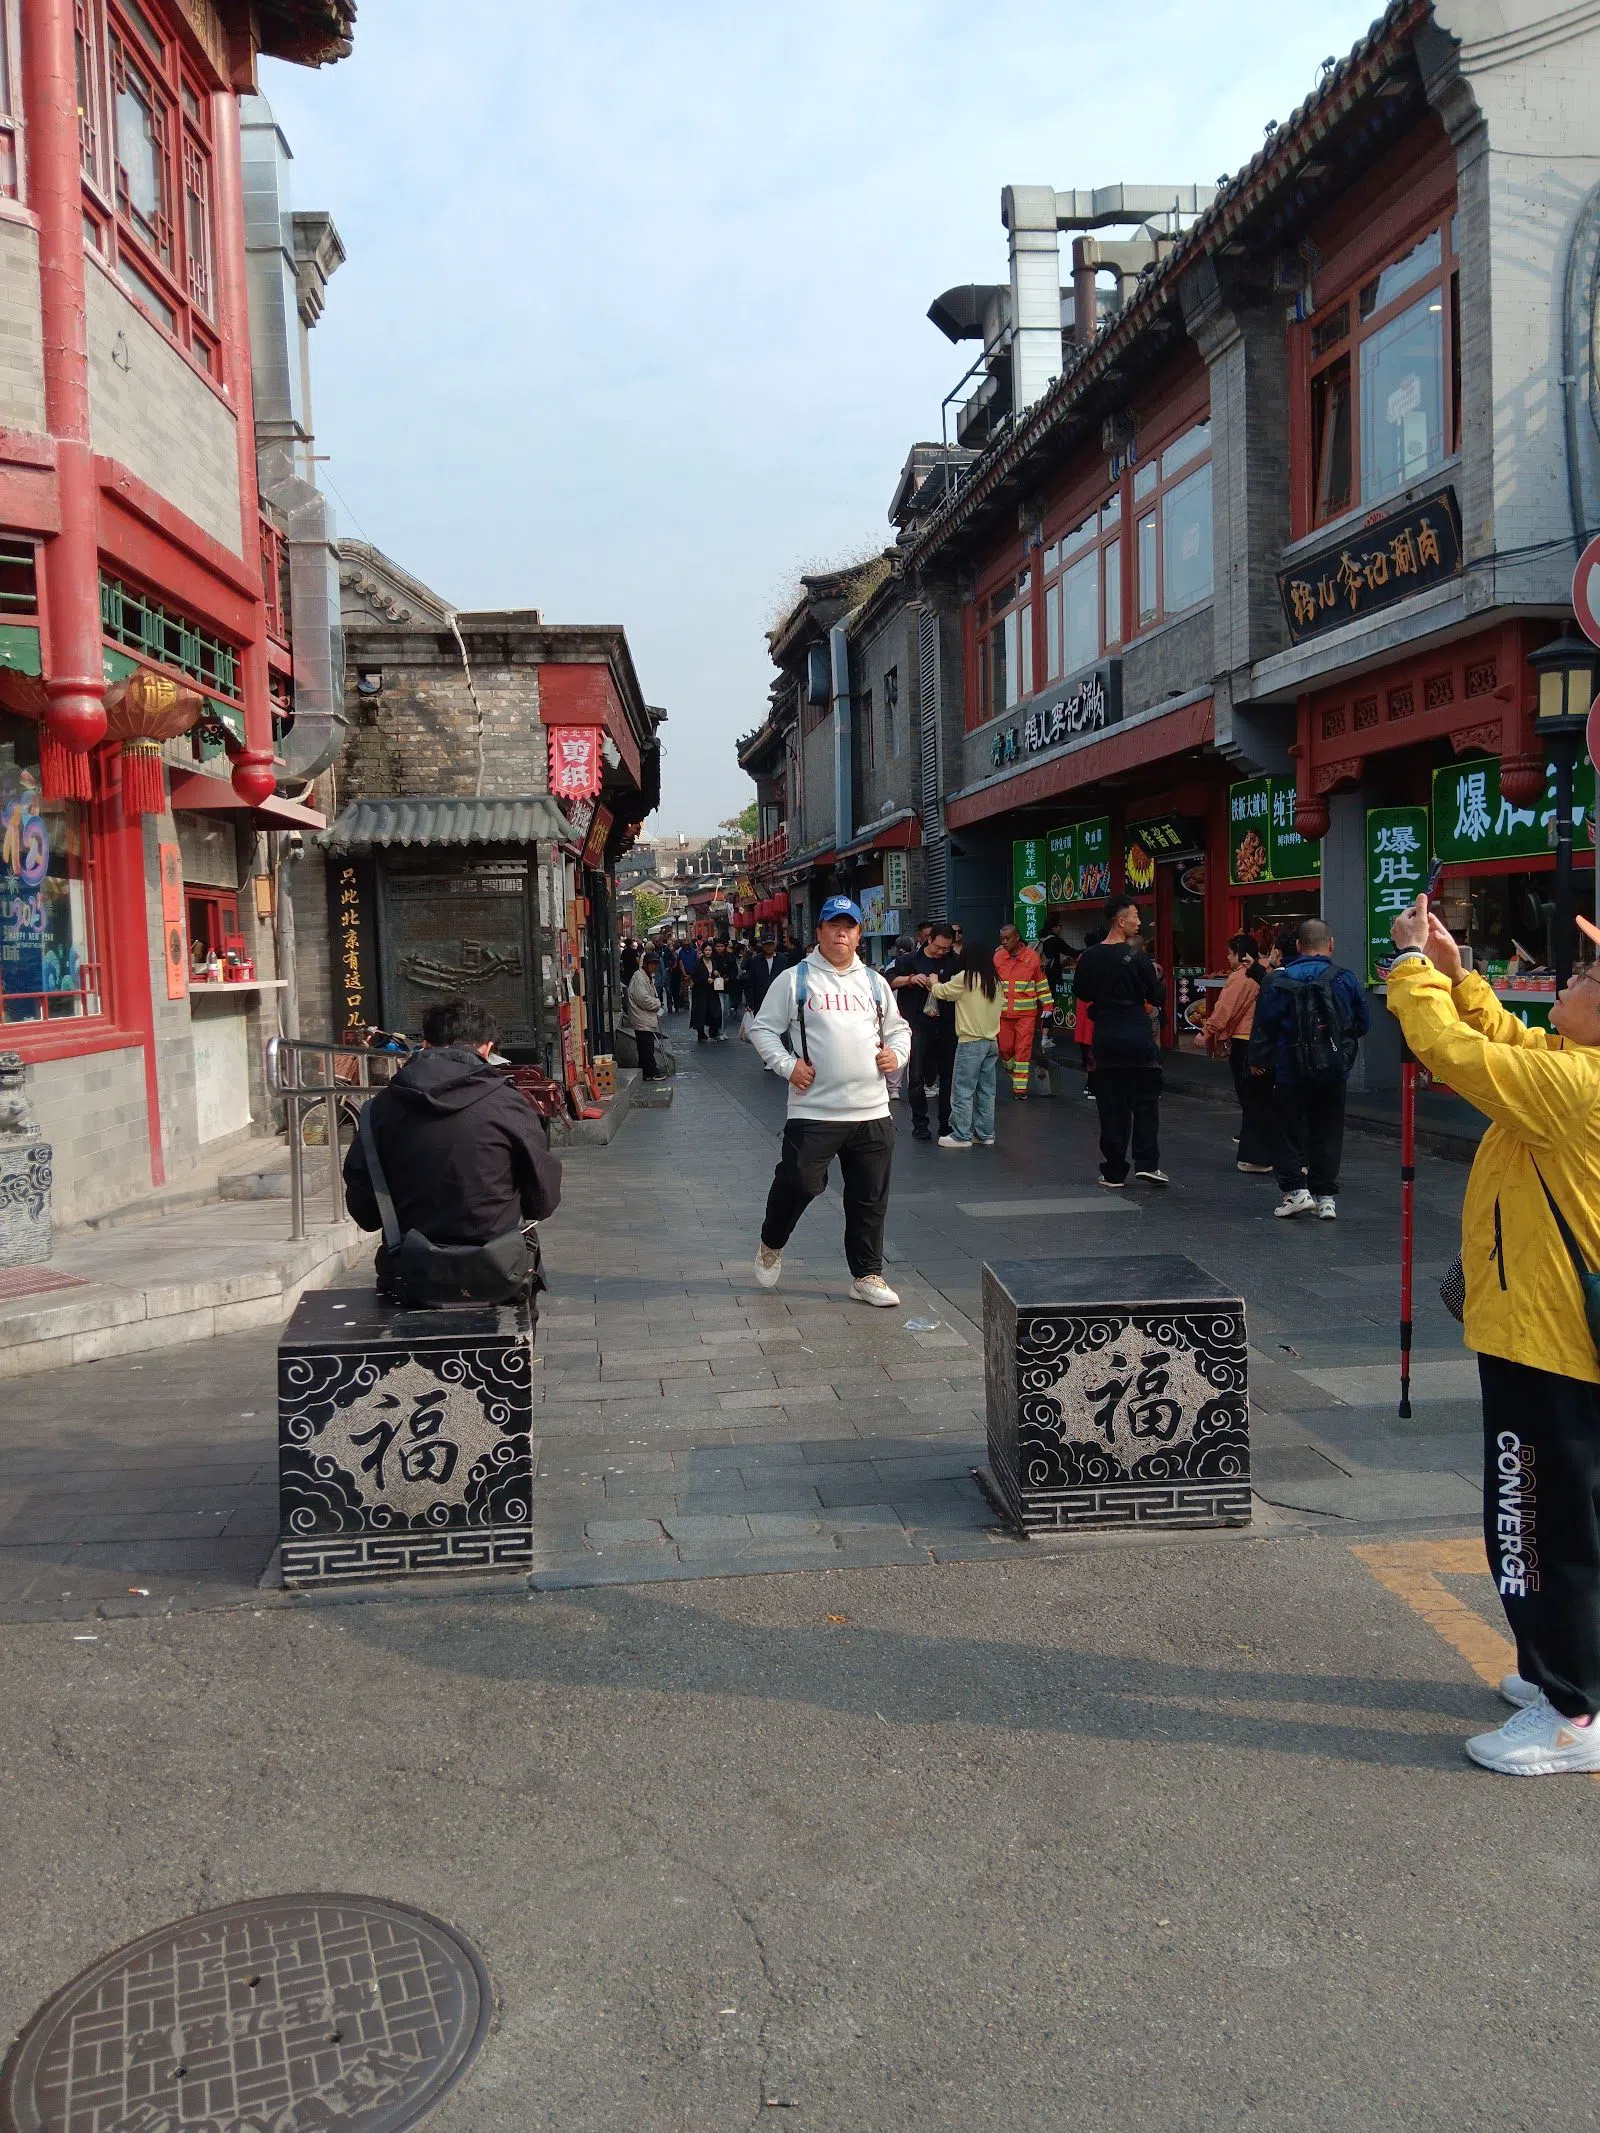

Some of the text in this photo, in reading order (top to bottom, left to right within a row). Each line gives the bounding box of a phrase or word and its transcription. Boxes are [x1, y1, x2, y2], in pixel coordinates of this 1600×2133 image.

[143, 676, 176, 710] 福
[558, 729, 593, 738] 老北京
[1373, 825, 1421, 913] 爆肚王
[339, 867, 366, 1028] 只此北京有这口儿
[807, 993, 877, 1013] CHINA
[348, 1388, 460, 1491] 福
[1085, 1351, 1183, 1445] 福
[1496, 1430, 1526, 1598] CONVERGE
